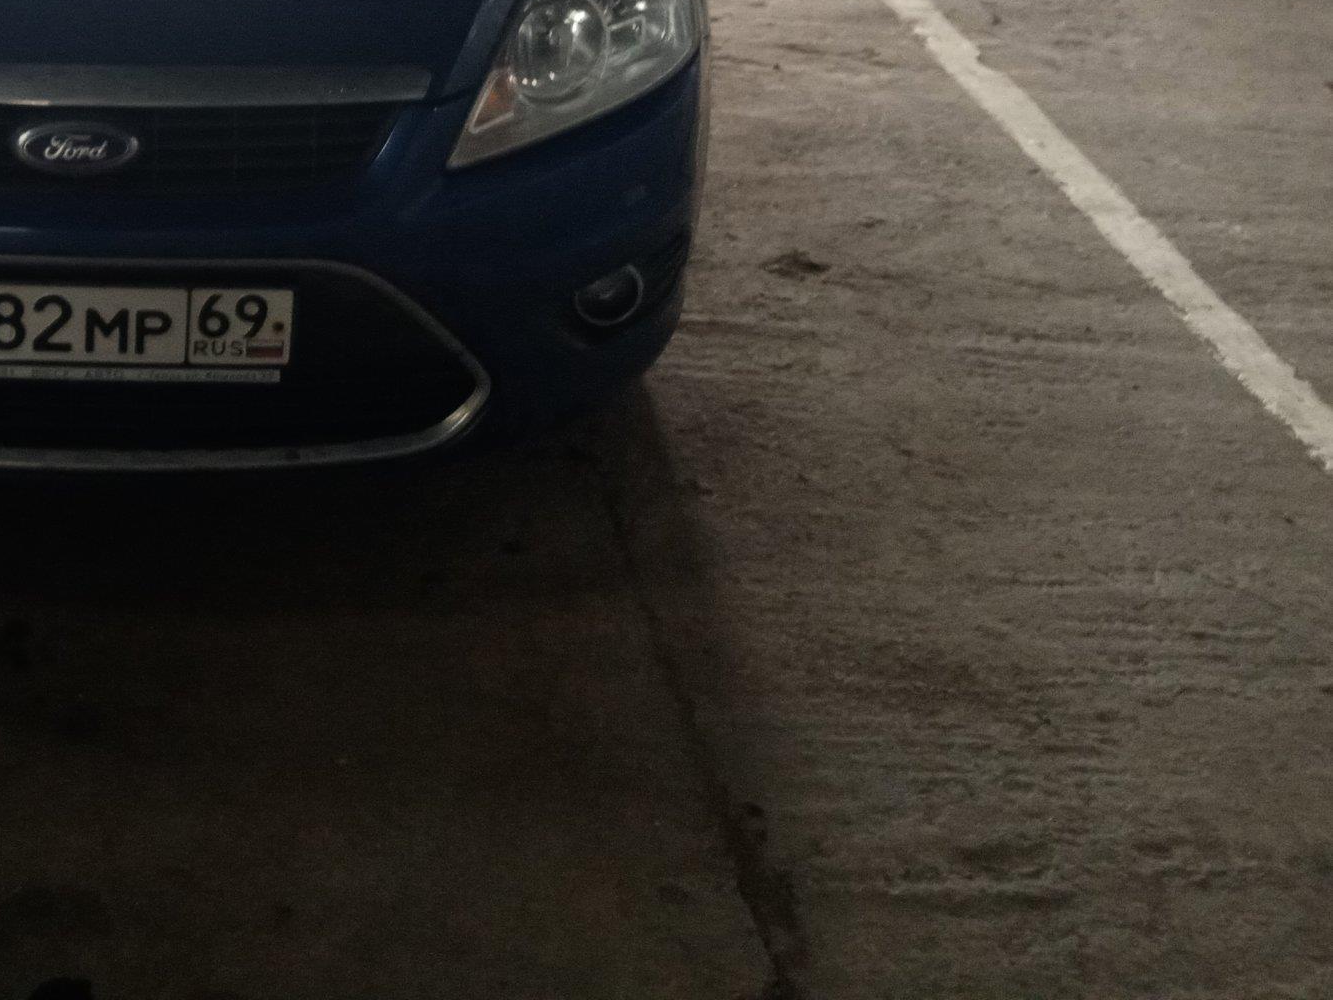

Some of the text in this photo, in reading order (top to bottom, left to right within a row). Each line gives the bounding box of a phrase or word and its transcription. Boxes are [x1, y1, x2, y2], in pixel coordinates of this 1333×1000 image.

[44, 135, 107, 160] Ford
[197, 293, 269, 338] 69
[193, 340, 245, 357] RUS
